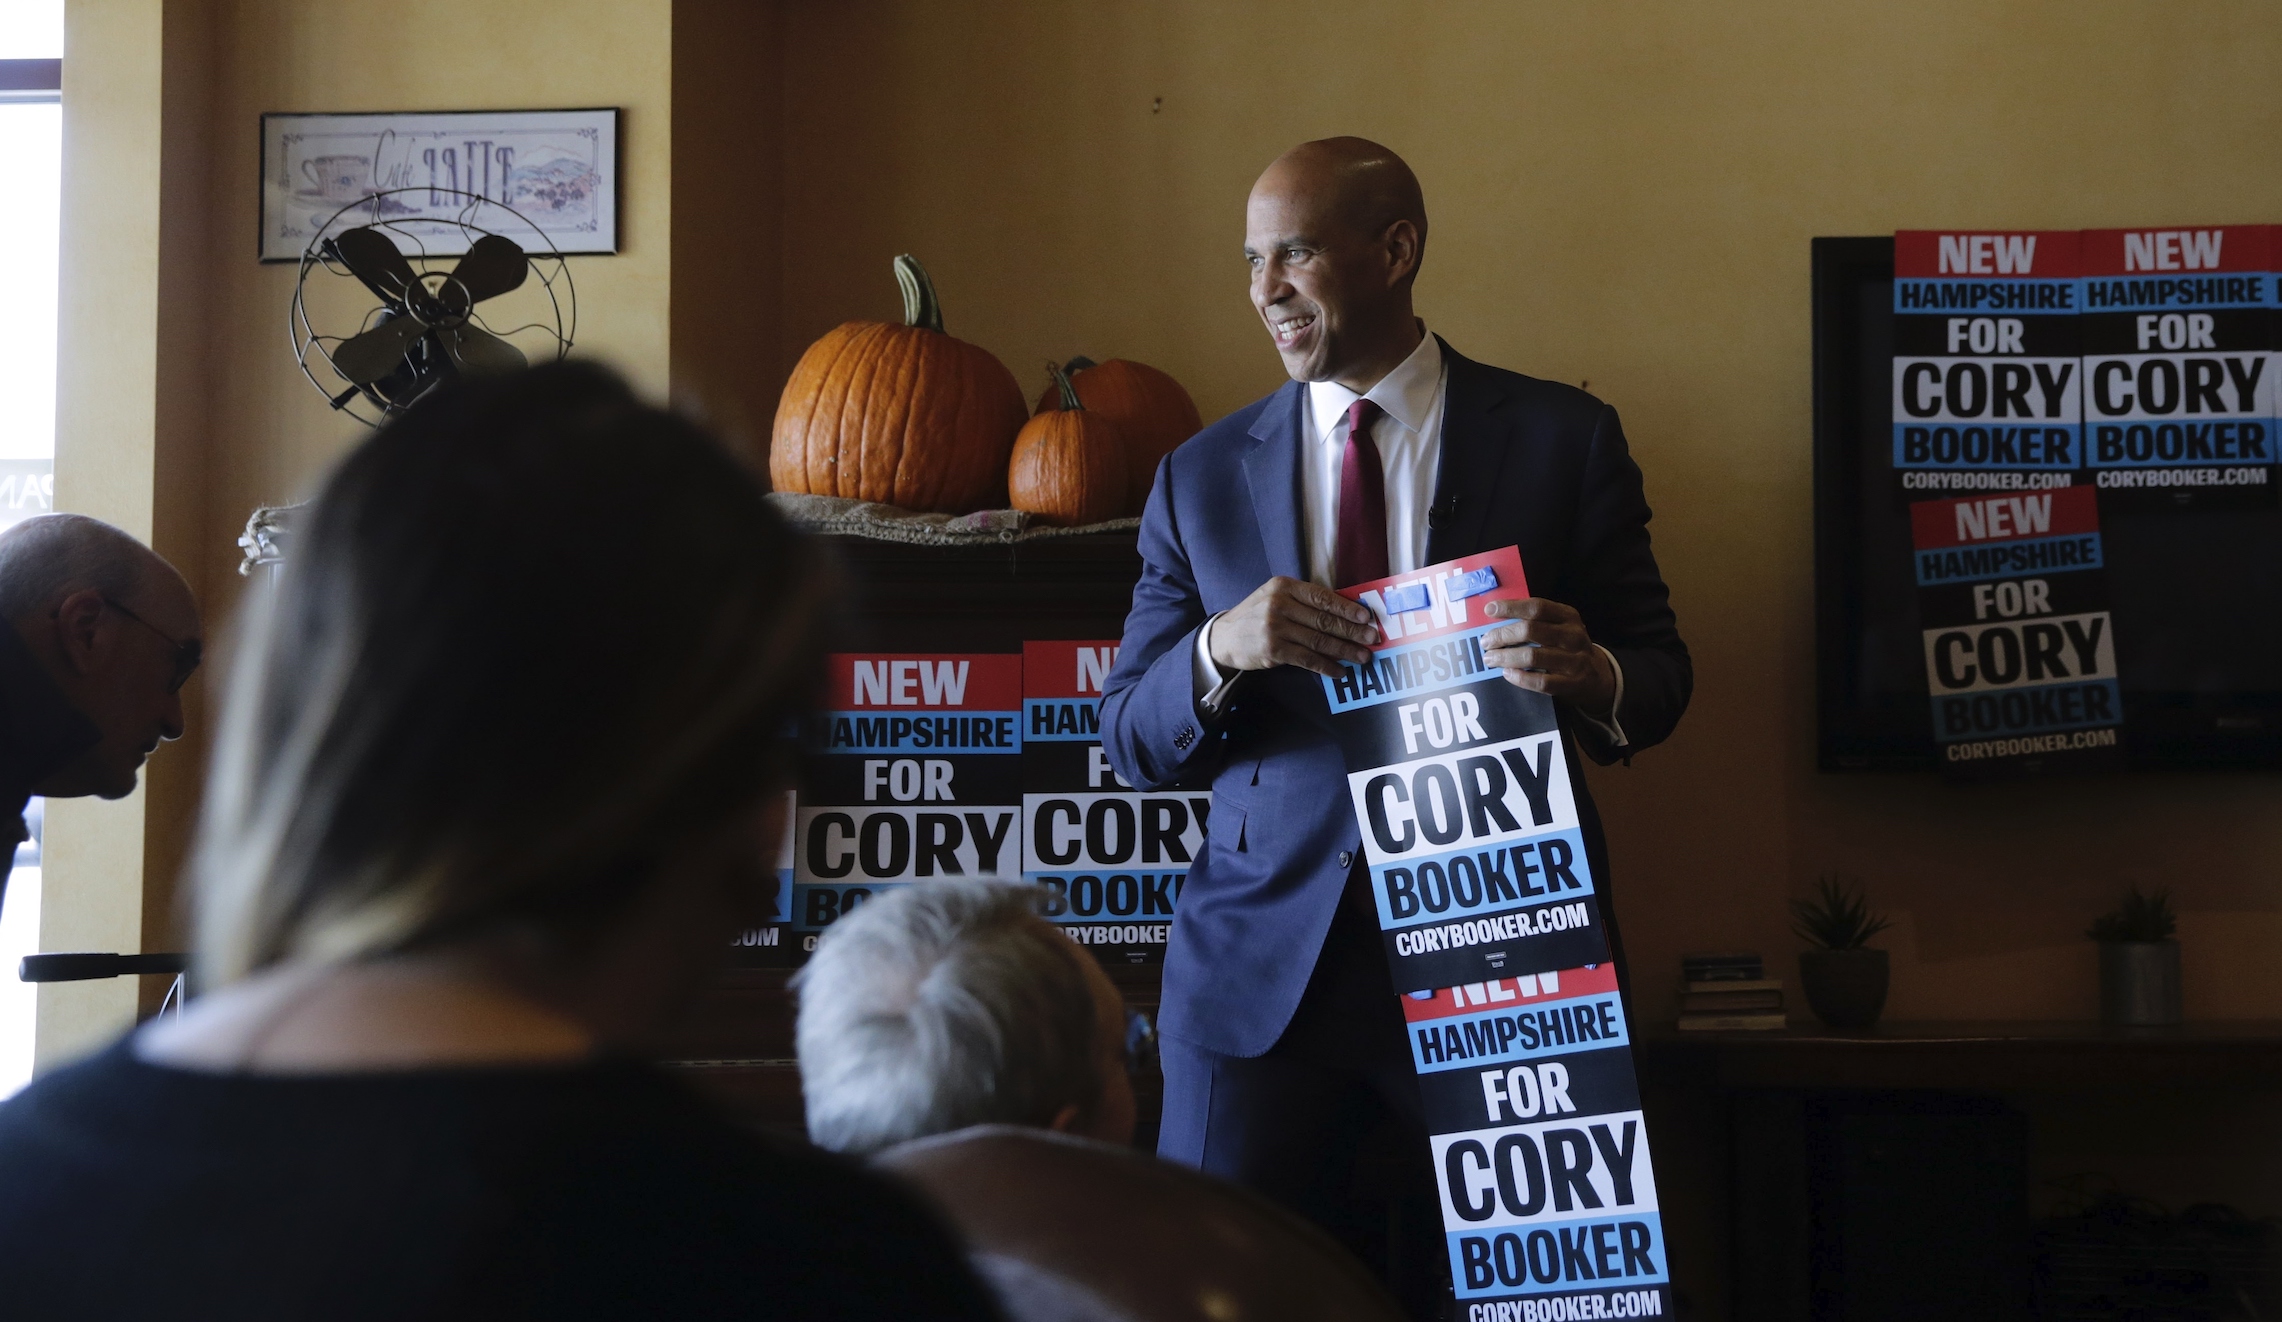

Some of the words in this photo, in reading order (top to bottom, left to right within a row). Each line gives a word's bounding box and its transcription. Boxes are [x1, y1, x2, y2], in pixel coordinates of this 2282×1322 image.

[1938, 235, 2037, 274] NEW
[2124, 231, 2223, 271] NEW
[1901, 283, 2073, 310] HAMPSHIRE
[2088, 277, 2263, 308] HAMPSHIRE
[1947, 318, 2025, 353] FOR
[2137, 314, 2216, 351] FOR
[1902, 362, 2073, 419] CORY
[2093, 357, 2265, 416] CORY
[1903, 427, 2071, 464] BOOKER
[2096, 422, 2267, 461] BOOKER
[1902, 472, 2072, 490] CORYBOOKER.COM
[2096, 468, 2268, 488] CORYBOOKER.COM
[1955, 494, 2052, 541] NEW
[1922, 538, 2096, 581] HAMPSHIRE
[1973, 579, 2052, 619] FOR
[1333, 634, 1498, 705] HAMPSHI
[1934, 617, 2104, 689] CORY
[853, 660, 969, 705] NEW
[1398, 691, 1488, 755] FOR
[1945, 684, 2113, 736] BOOKER
[1947, 729, 2116, 762] CORYBOOKER.COM
[863, 758, 956, 802] FOR
[1364, 740, 1554, 854] CORY
[806, 812, 1014, 879] CORY
[1383, 837, 1583, 921] BOOKER
[1395, 902, 1590, 957] CORYBOOKER.COM
[1417, 1000, 1620, 1065] HAMPSHIRE
[1481, 1062, 1576, 1122] FOR
[1445, 1119, 1638, 1222] CORY
[1459, 1220, 1658, 1291] BOOKER
